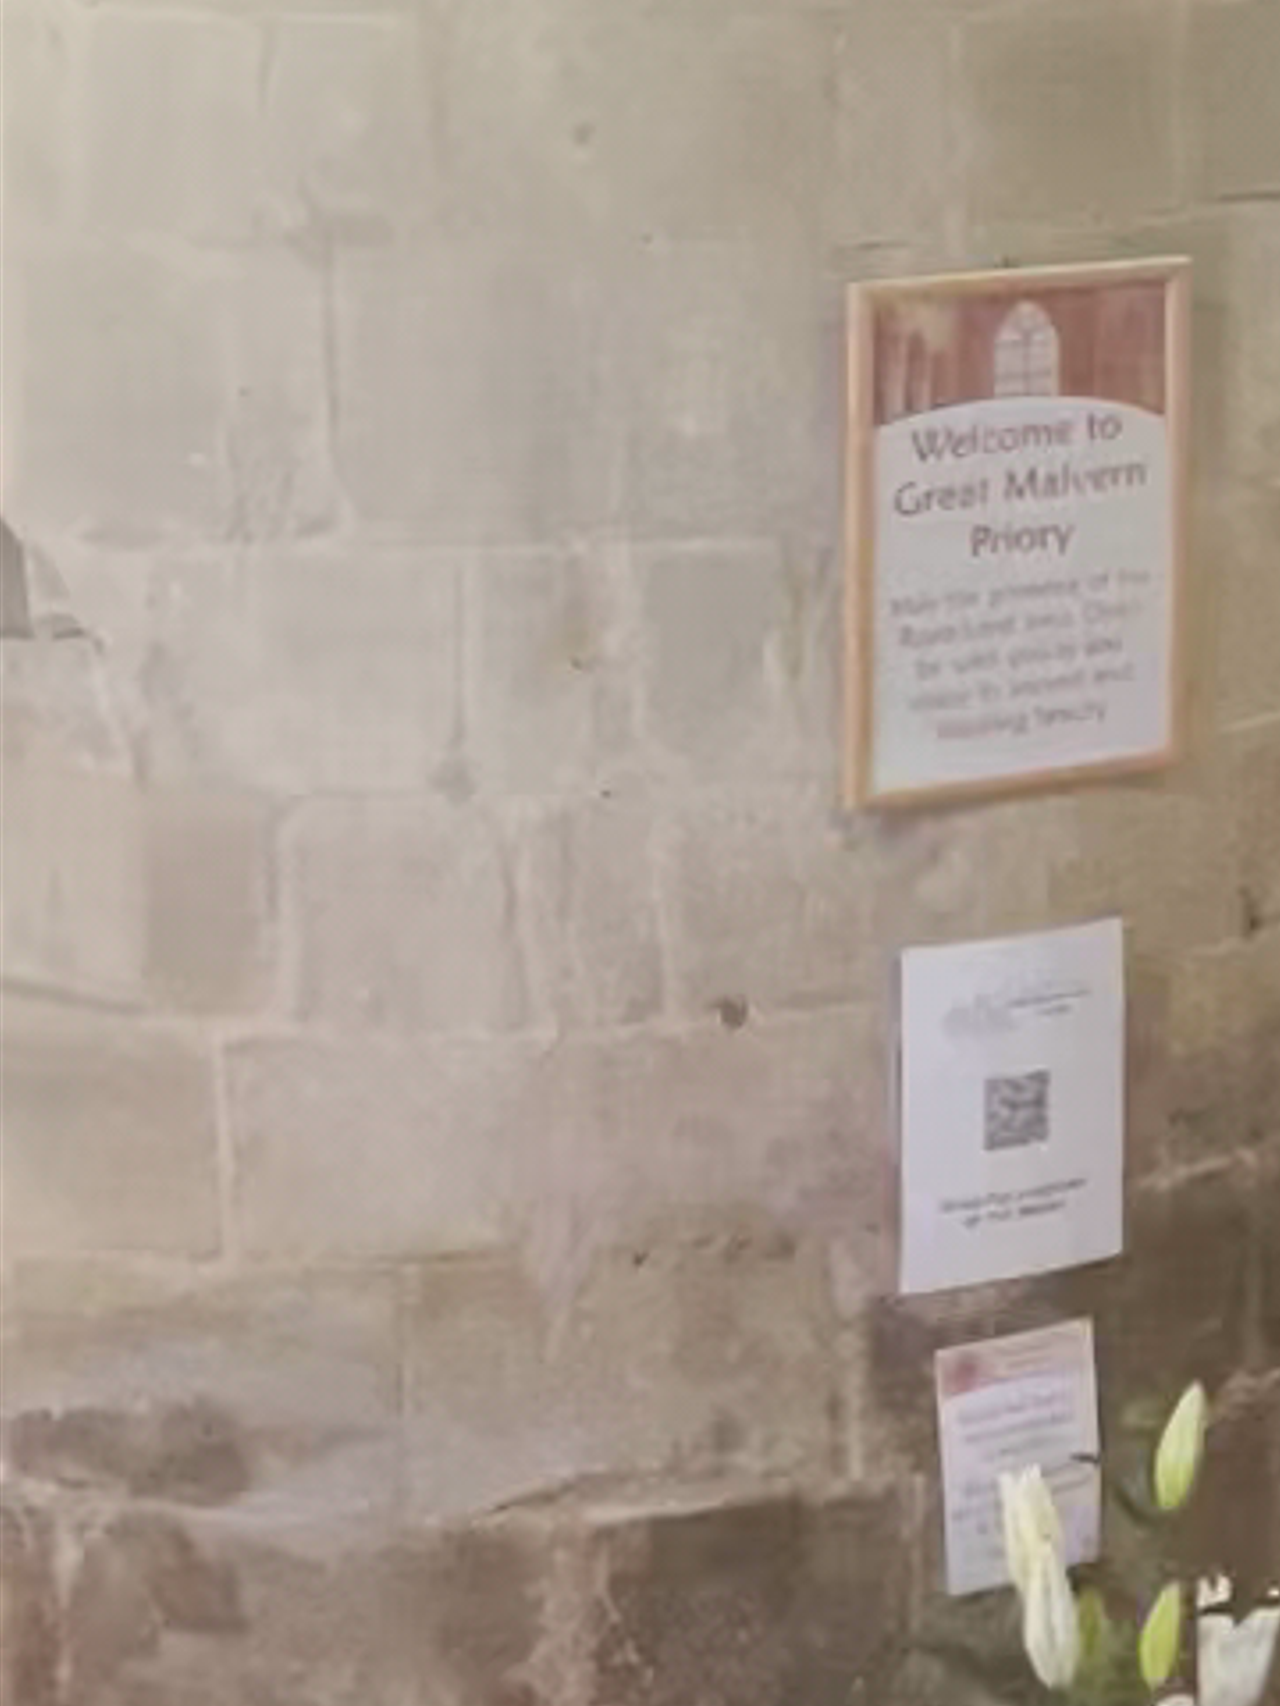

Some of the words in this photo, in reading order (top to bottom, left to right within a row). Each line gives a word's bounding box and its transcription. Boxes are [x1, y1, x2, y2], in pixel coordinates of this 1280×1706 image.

[911, 419, 1074, 462] Welcome
[1087, 411, 1123, 440] to
[894, 478, 989, 516] Great
[1004, 463, 1147, 501] Malvern
[971, 523, 1076, 557] Priory
